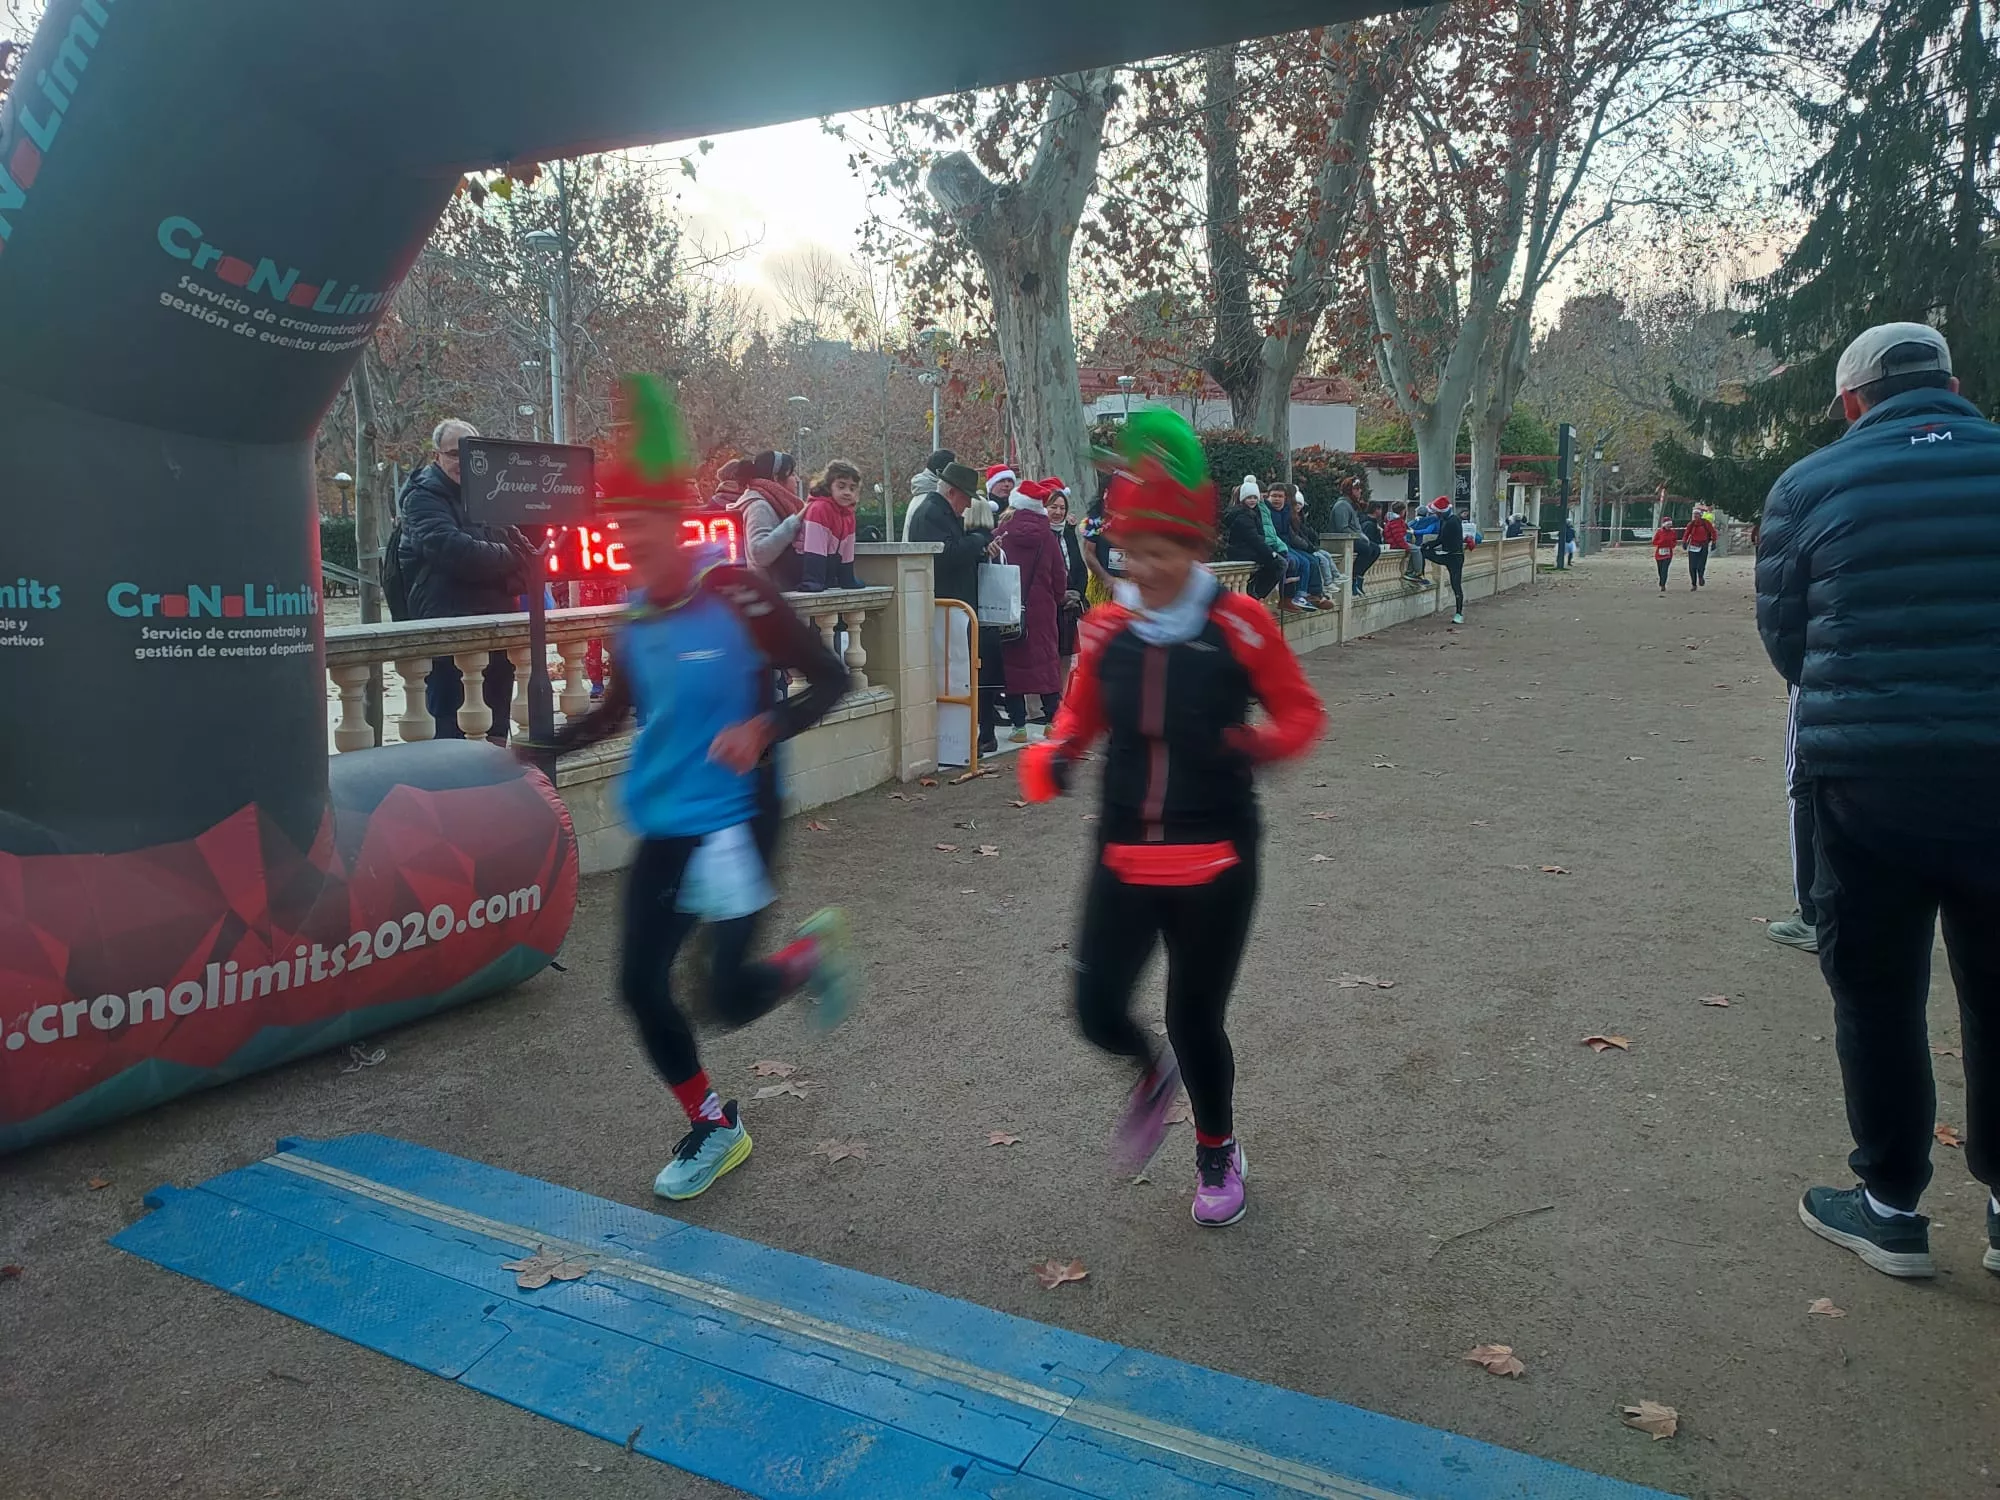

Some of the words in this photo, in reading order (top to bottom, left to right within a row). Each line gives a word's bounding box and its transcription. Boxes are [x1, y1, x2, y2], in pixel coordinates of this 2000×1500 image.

[178, 275, 250, 315] Servicio
[253, 307, 277, 324] de
[159, 291, 230, 329] gestión
[232, 321, 257, 338] de
[259, 331, 317, 351] eventos
[486, 469, 538, 500] Javier
[541, 473, 585, 495] Tomeo
[19, 619, 28, 632] y
[141, 626, 202, 641] Servicio
[205, 626, 225, 641] de
[301, 626, 308, 639] y
[0, 634, 45, 647] ortivos
[134, 645, 193, 660] gestión
[197, 644, 216, 658] de
[219, 644, 267, 657] eventos
[0, 883, 542, 1052] .cronolimits2020.com
